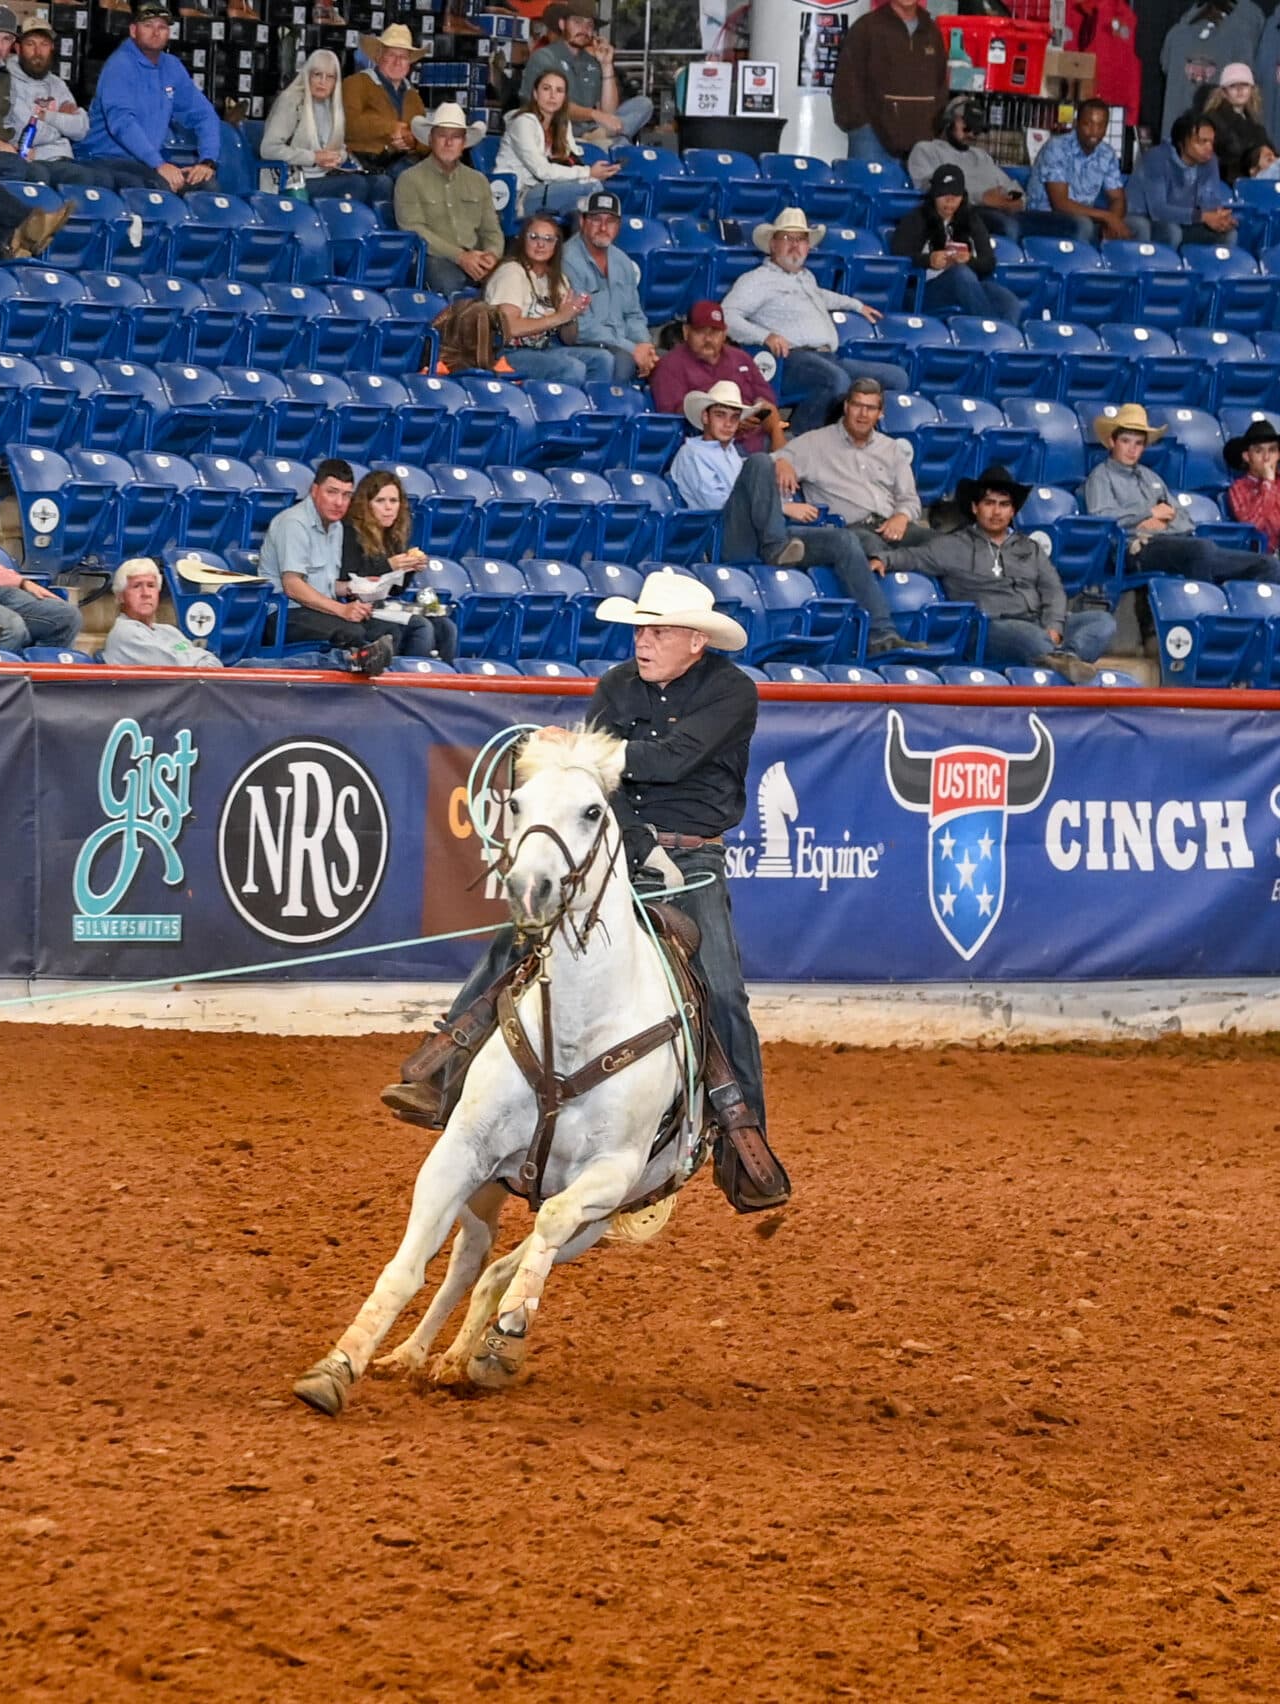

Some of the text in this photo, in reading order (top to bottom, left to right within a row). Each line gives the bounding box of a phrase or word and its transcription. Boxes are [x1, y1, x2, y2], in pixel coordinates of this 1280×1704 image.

[937, 762, 1002, 801] USTRC
[73, 718, 198, 917] Gist
[241, 761, 360, 918] NRS
[1045, 799, 1255, 872] CINCH
[724, 827, 879, 891] sic Equine
[76, 919, 180, 937] SILVERSMITHS
